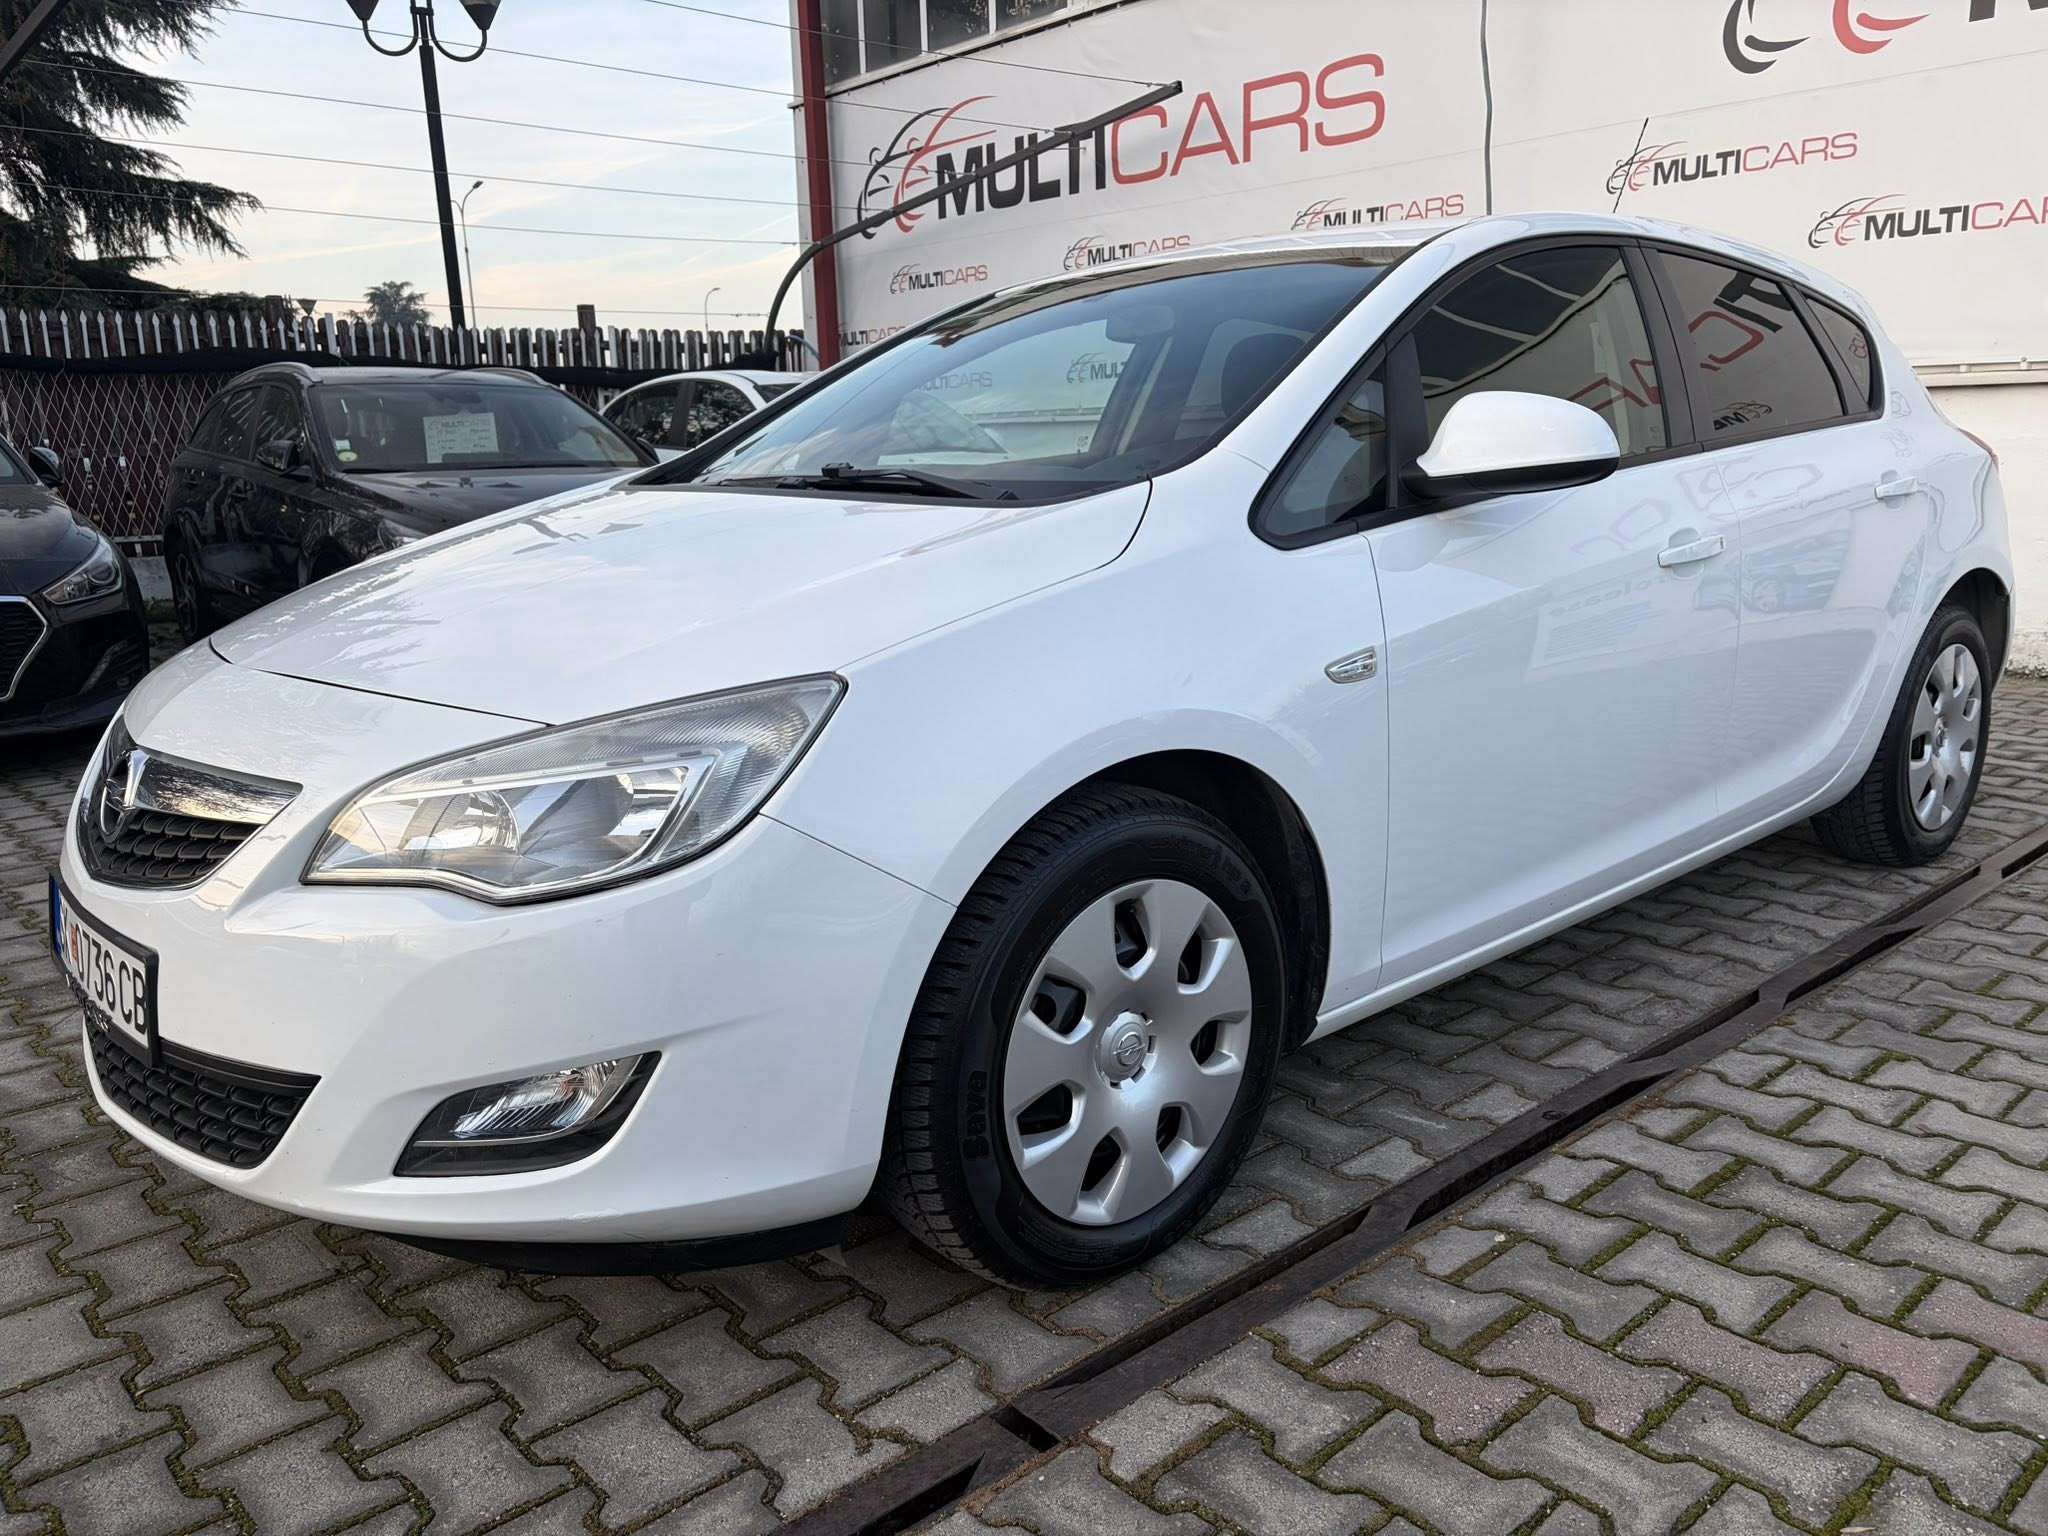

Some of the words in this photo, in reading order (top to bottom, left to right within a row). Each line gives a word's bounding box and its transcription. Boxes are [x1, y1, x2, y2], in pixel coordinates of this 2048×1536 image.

[936, 53, 1386, 219] MULTICARS
[1652, 132, 1858, 186] MULTICARS
[1864, 196, 2048, 241] MULTICA
[908, 265, 988, 291] MULTICARS
